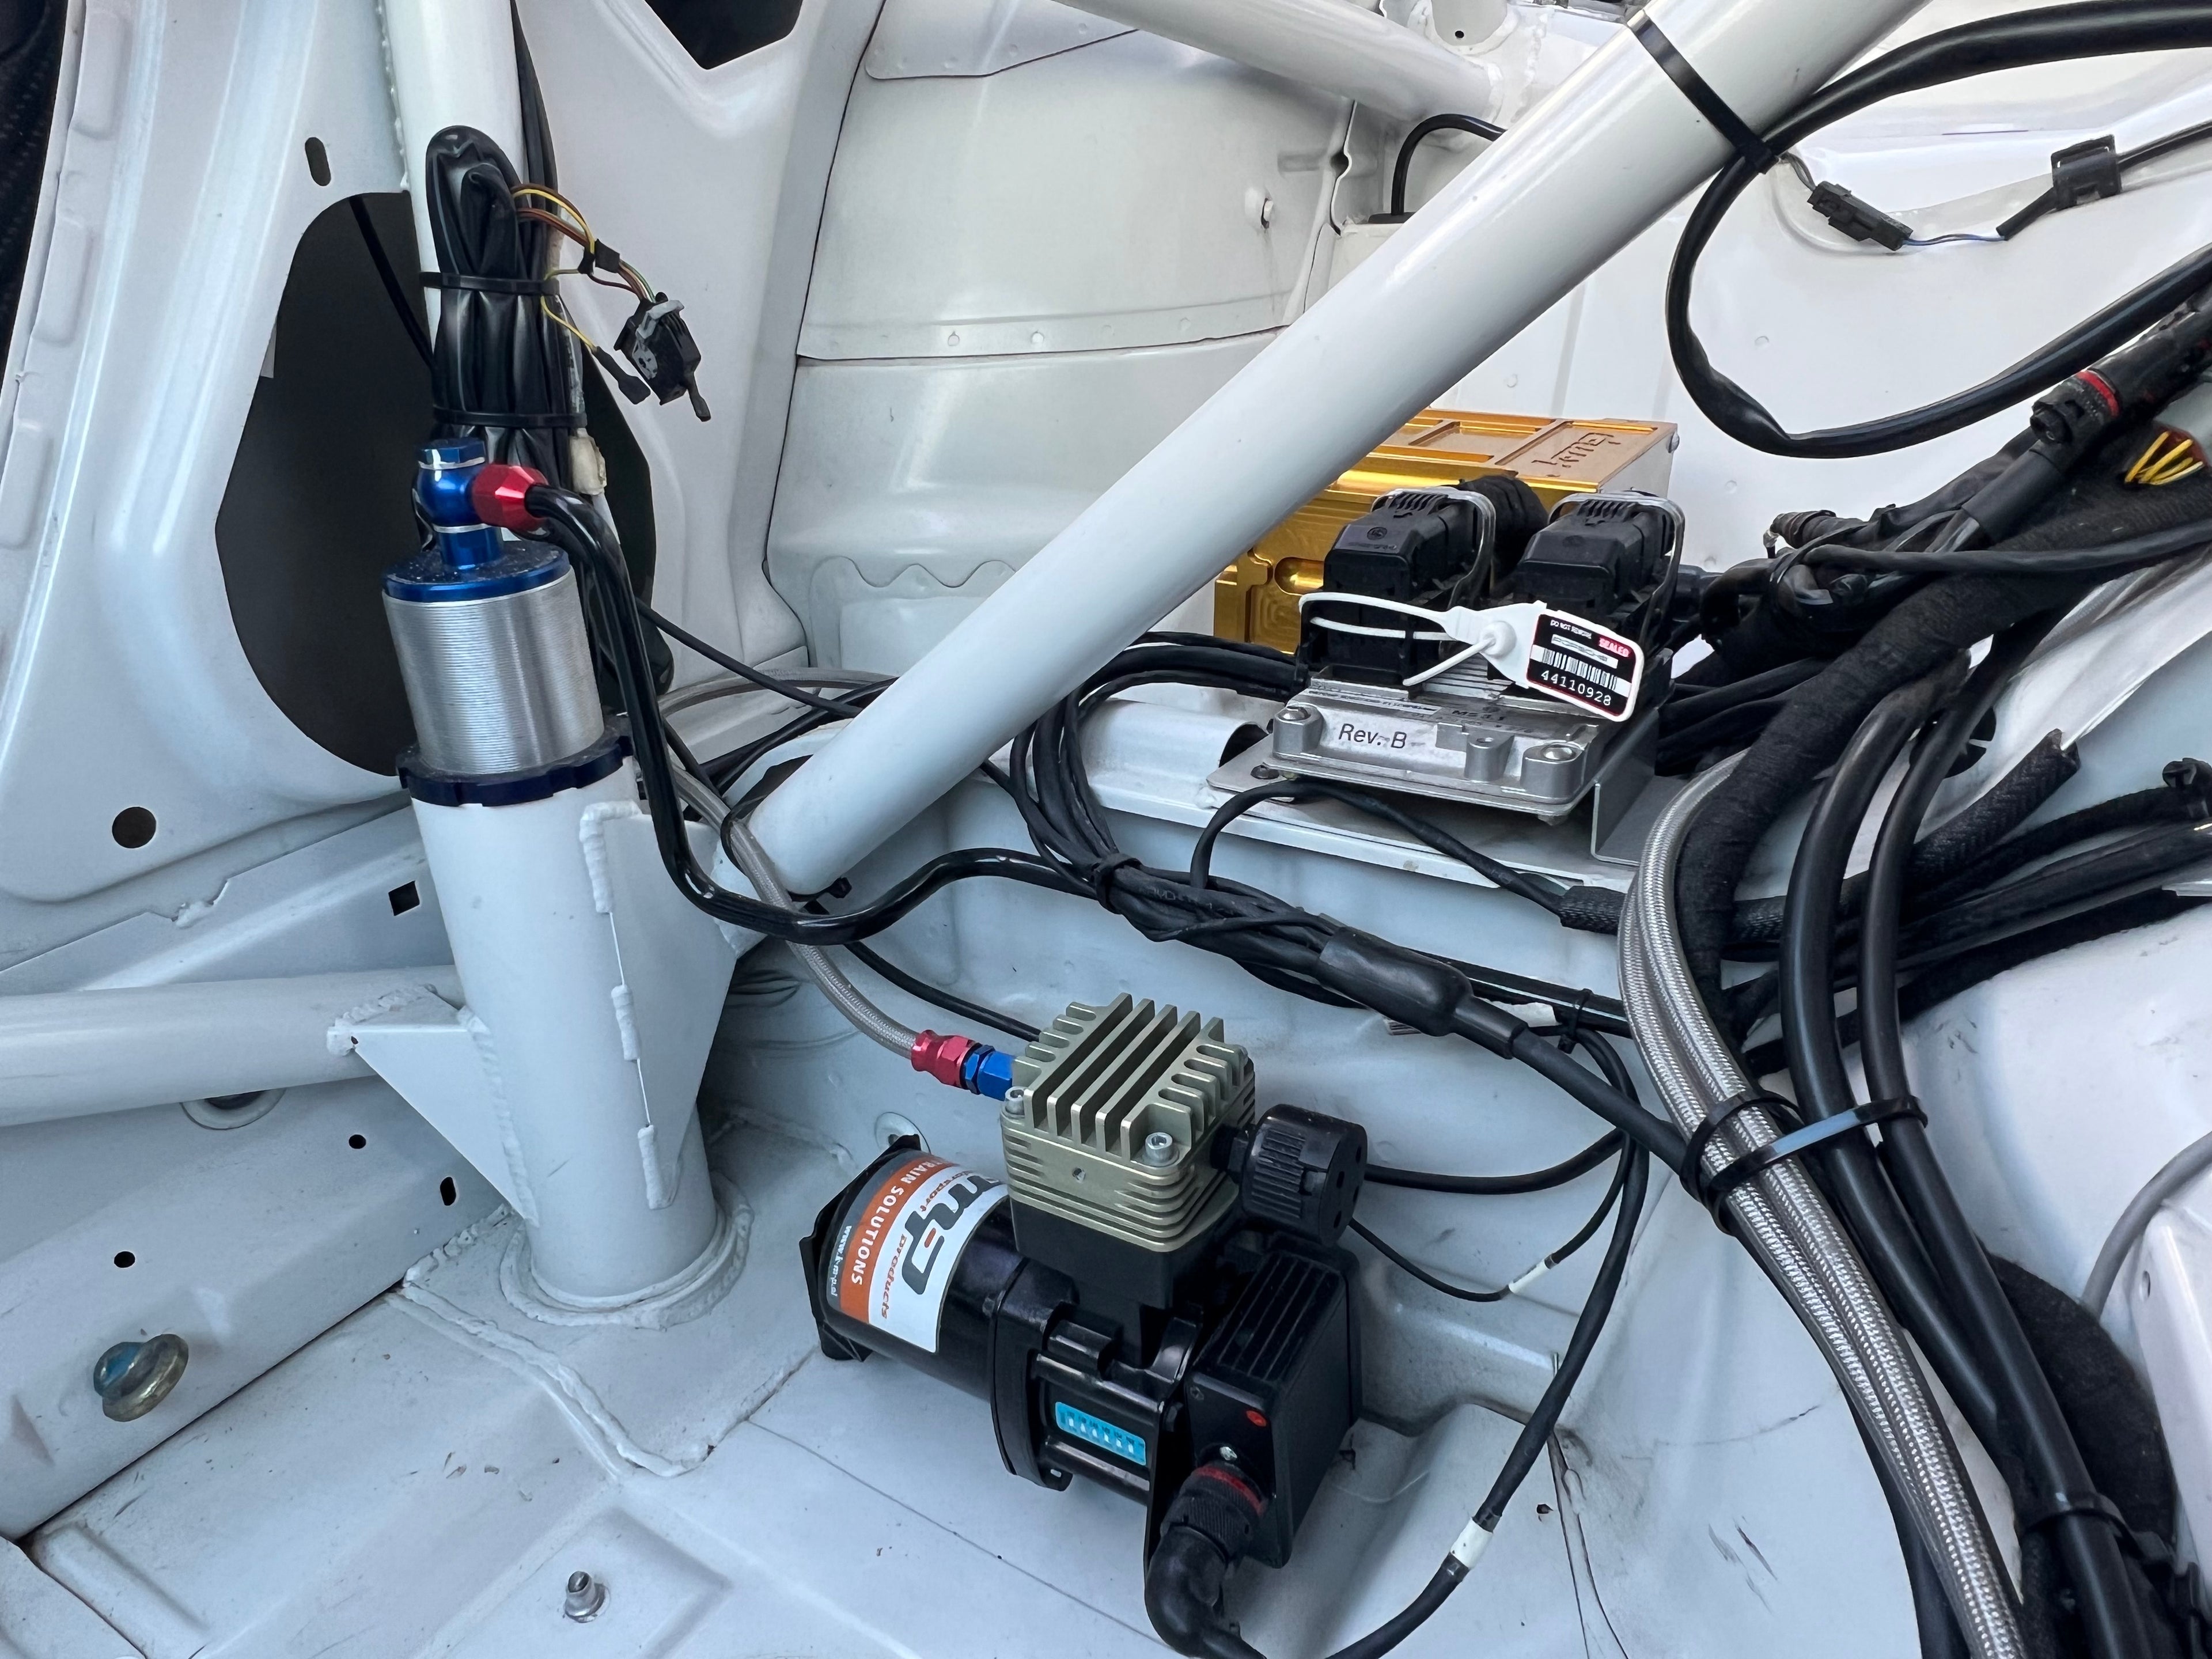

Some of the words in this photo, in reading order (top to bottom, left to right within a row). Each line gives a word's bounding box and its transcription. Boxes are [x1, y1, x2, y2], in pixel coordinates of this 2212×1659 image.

[1541, 670, 1611, 706] 44110928
[1338, 723, 1381, 746] Rev.
[1391, 731, 1407, 749] B
[851, 1185, 905, 1285] SOLUTIONS
[882, 1234, 907, 1319] products
